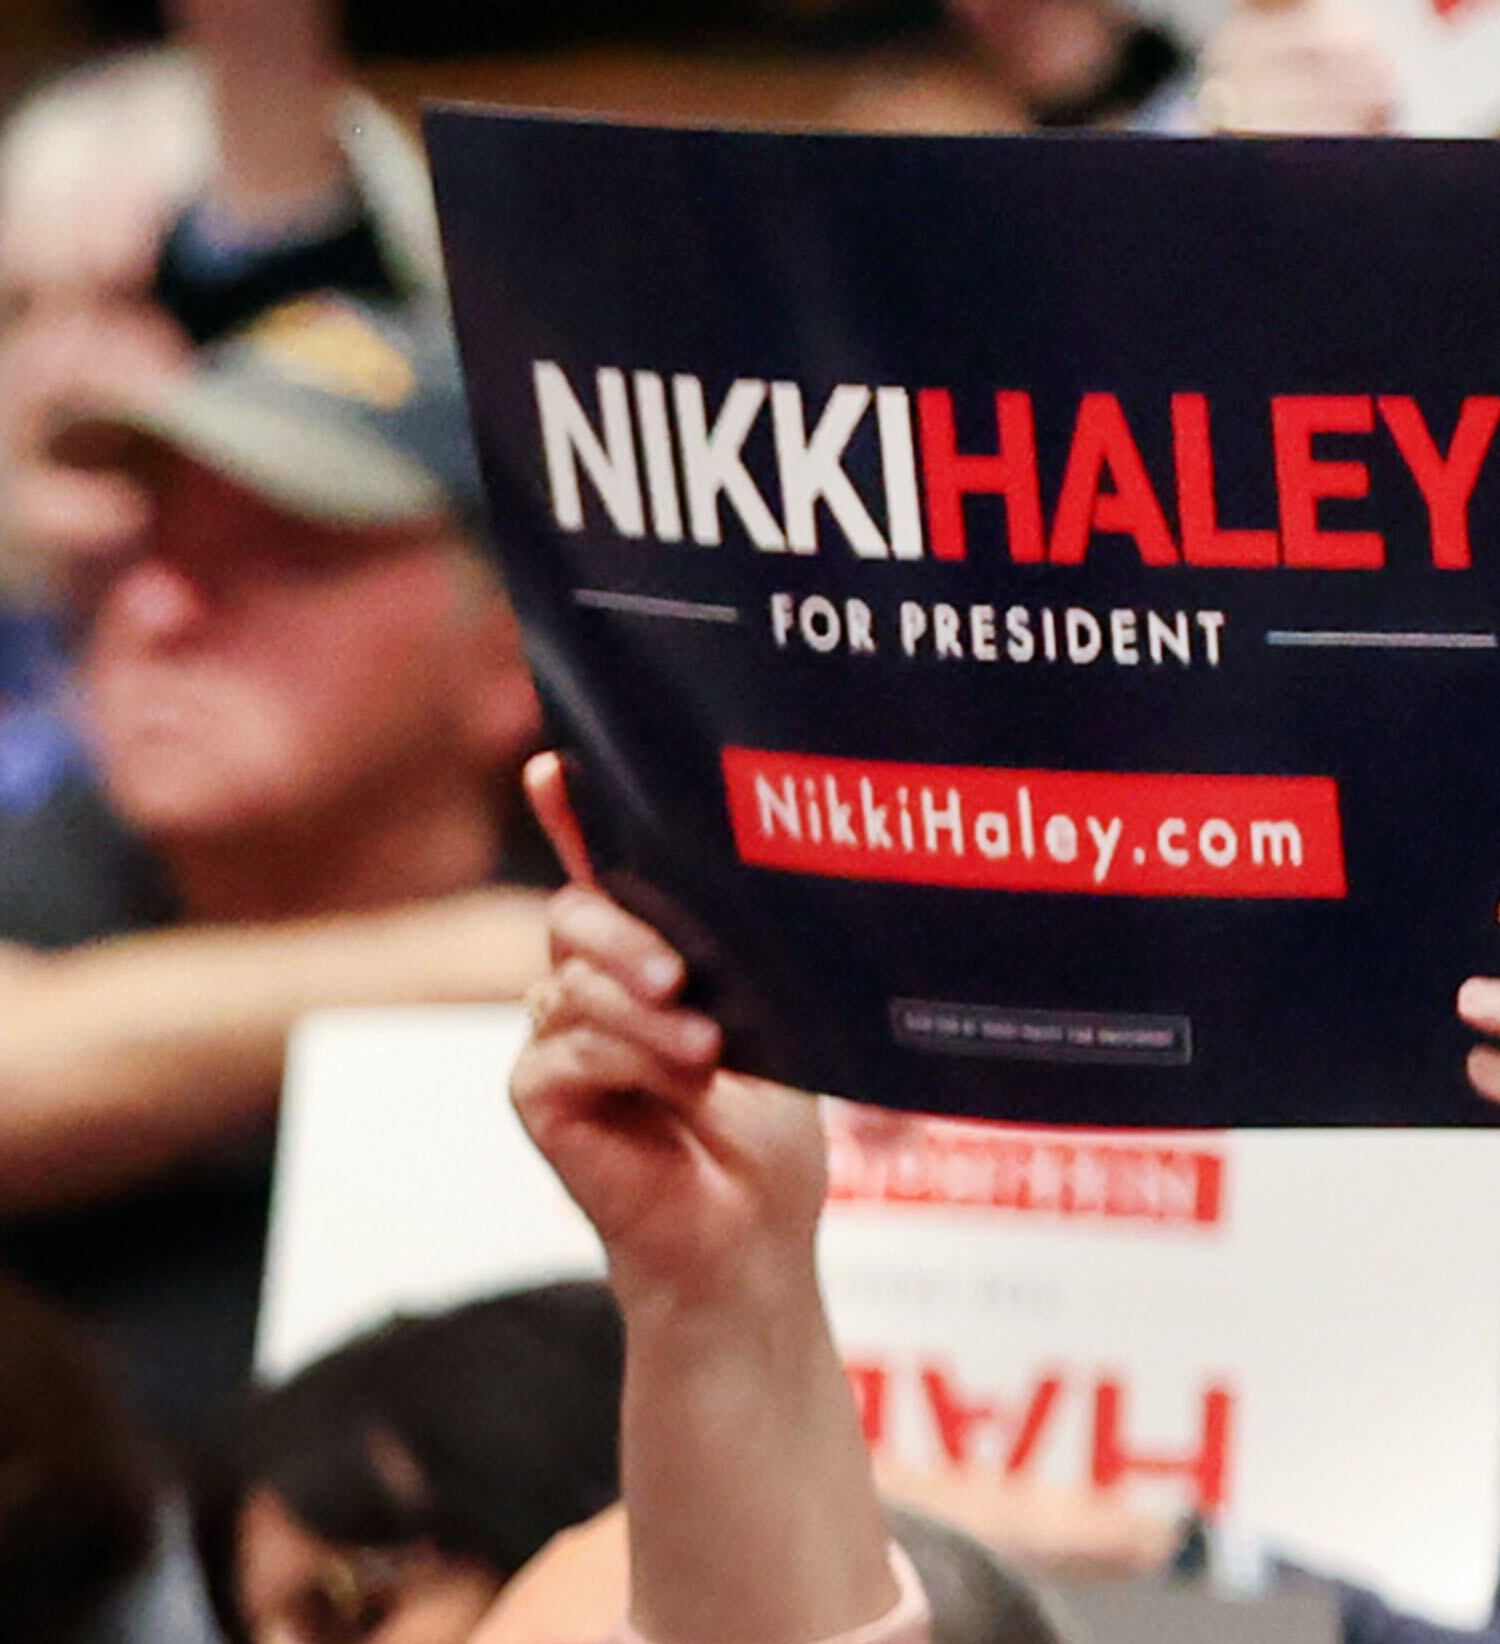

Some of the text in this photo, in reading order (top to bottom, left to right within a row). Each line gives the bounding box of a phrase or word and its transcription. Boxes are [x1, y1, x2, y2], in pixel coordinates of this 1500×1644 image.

[769, 591, 1227, 668] FOR PRESIDENT
[753, 772, 1304, 885] NikkiHaley.com
